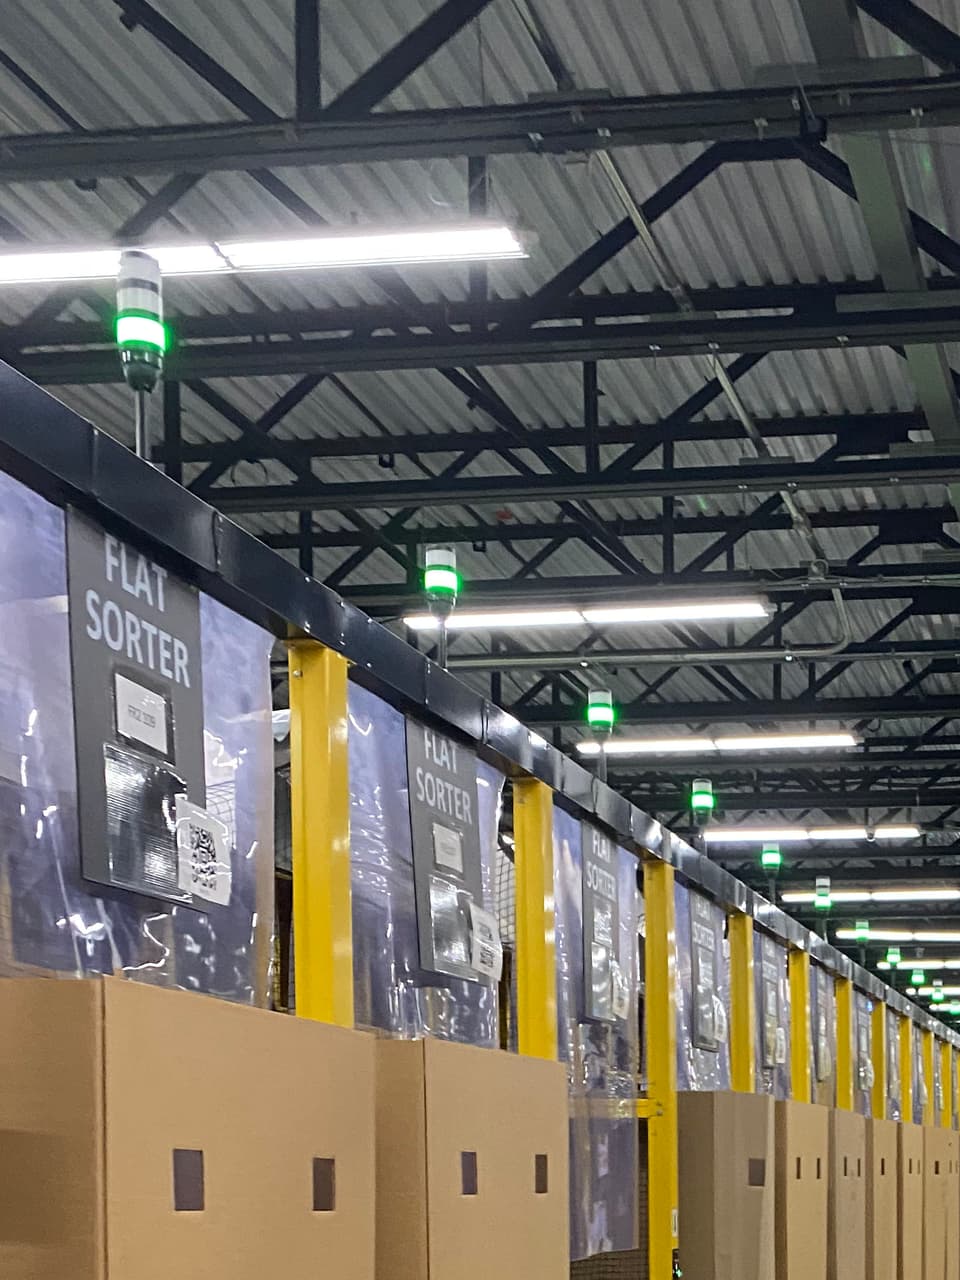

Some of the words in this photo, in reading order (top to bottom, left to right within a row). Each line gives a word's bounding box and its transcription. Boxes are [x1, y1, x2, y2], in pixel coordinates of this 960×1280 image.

[104, 532, 168, 612] FLAT
[85, 589, 190, 688] SORTER
[424, 728, 458, 773] FLAT
[415, 767, 472, 825] SORTER
